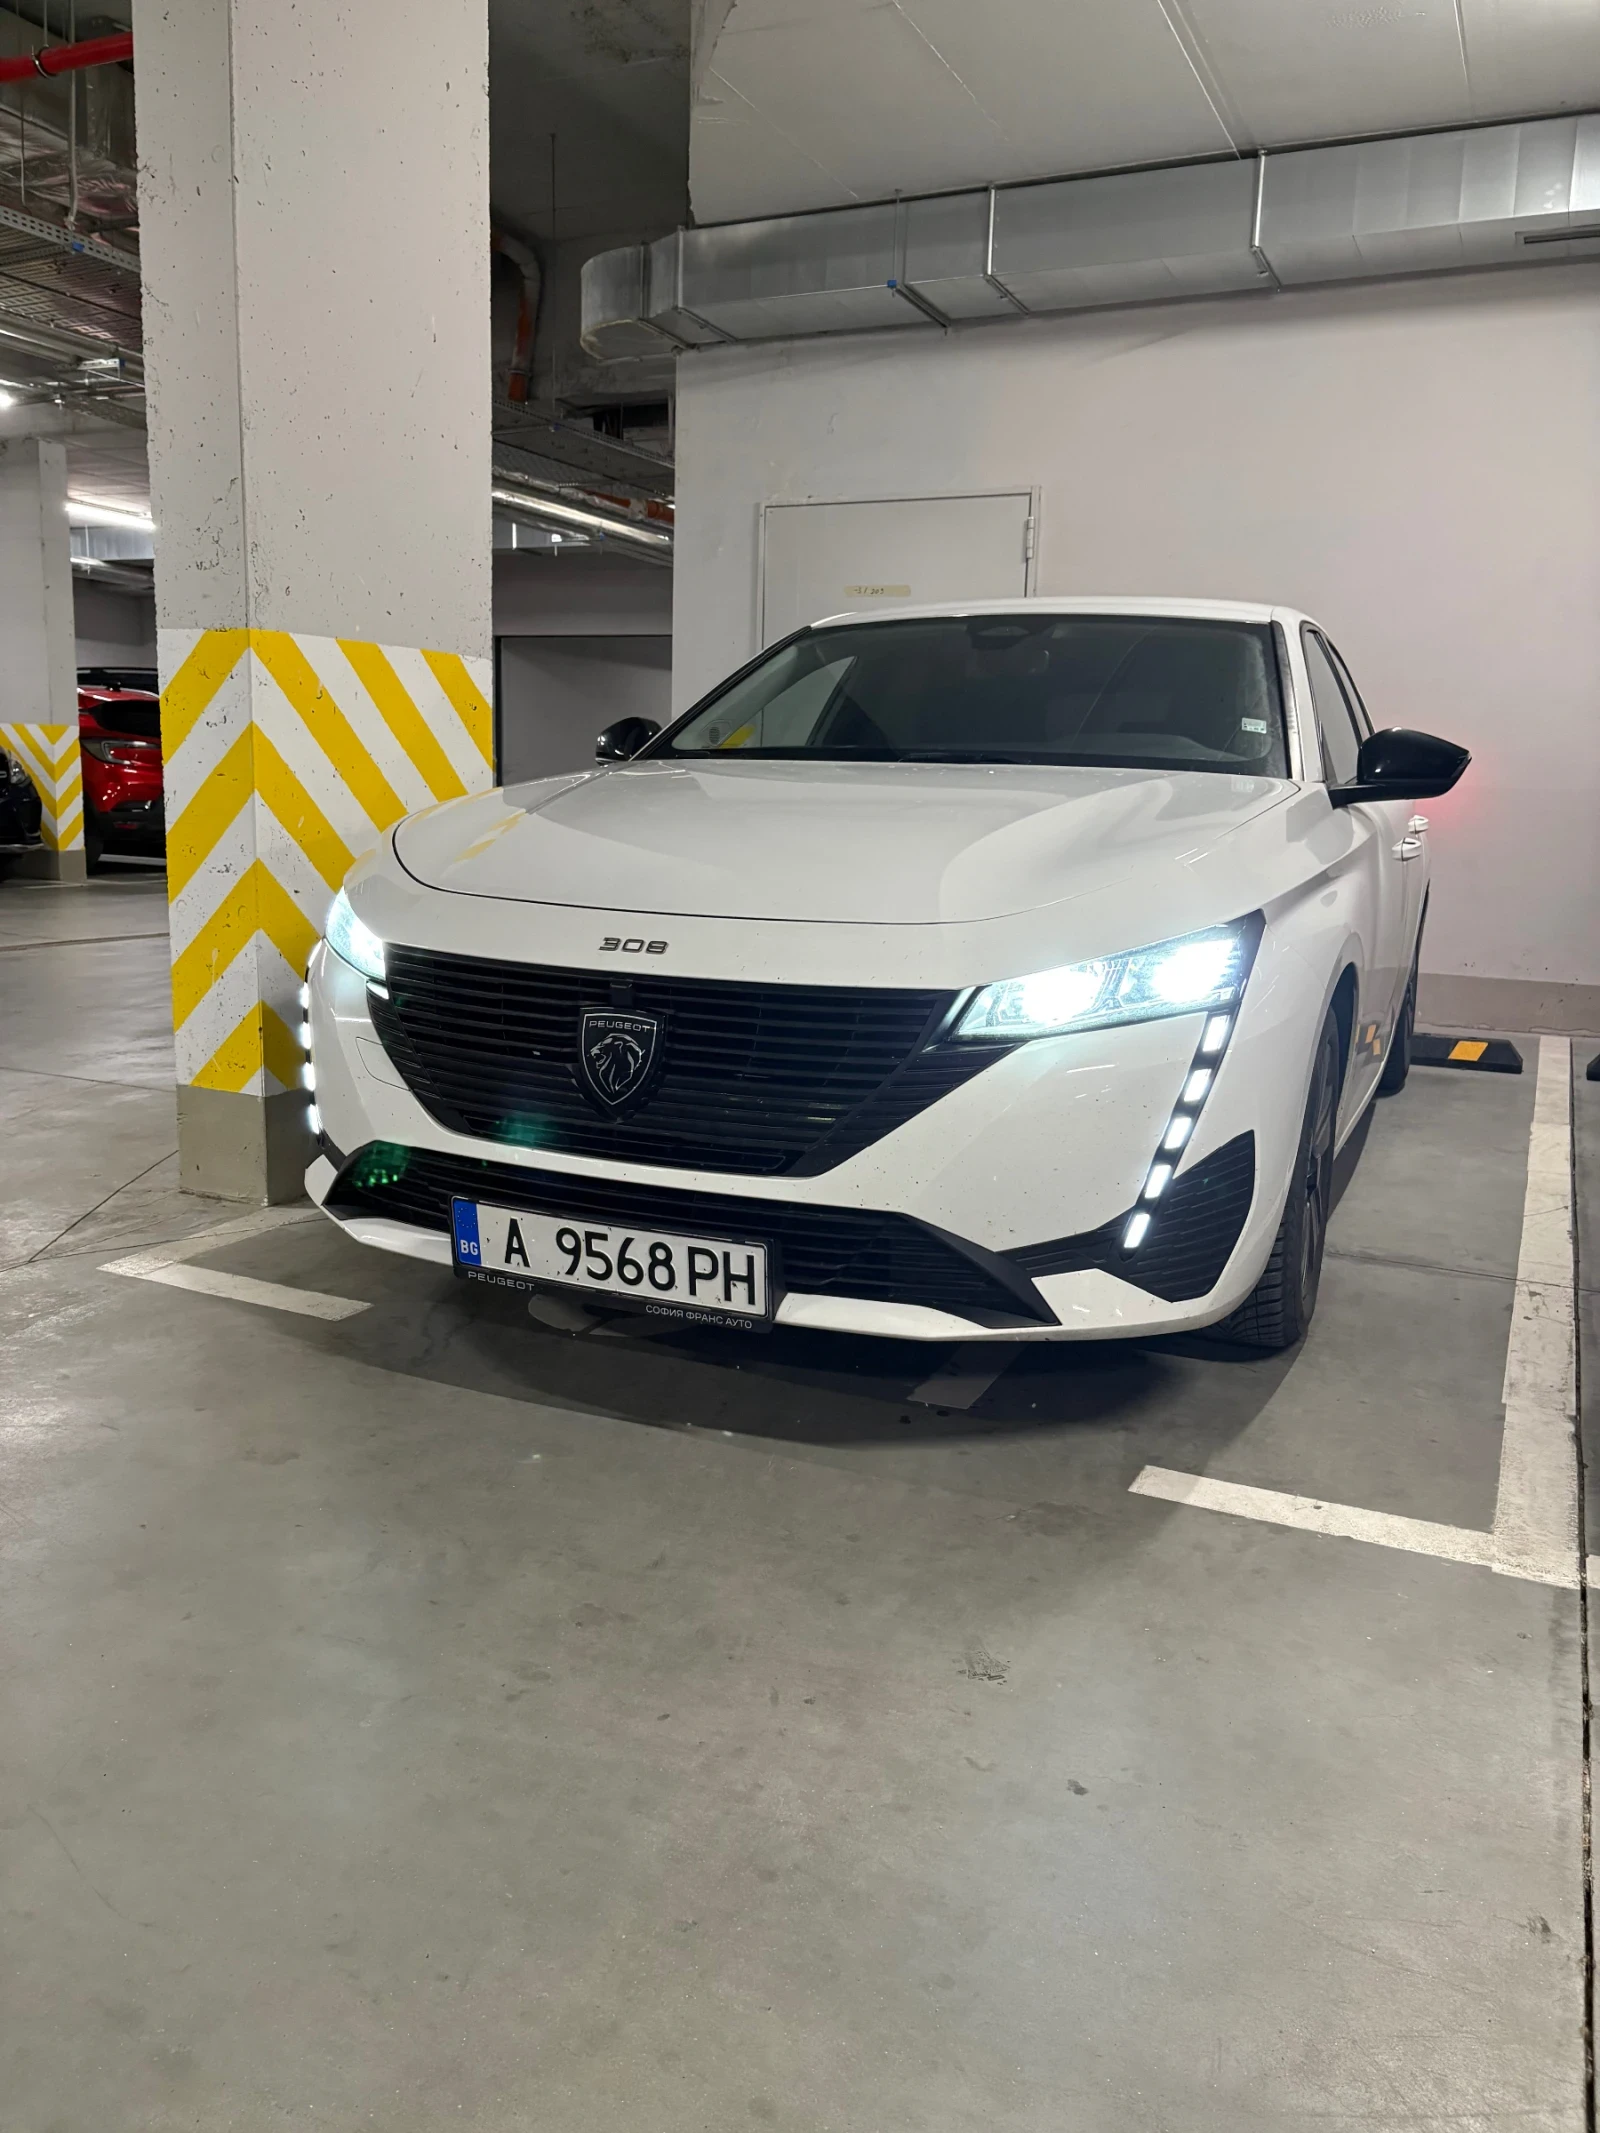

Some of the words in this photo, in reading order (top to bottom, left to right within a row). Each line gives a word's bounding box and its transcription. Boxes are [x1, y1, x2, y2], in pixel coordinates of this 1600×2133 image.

[599, 937, 668, 955] 308
[589, 1020, 651, 1033] PEUGEOT
[460, 1239, 479, 1256] BG
[556, 1227, 676, 1291] 9568
[467, 1270, 535, 1291] PEUGEOT
[645, 1304, 684, 1318] СОФИЯ
[685, 1311, 724, 1325] ФРАНС
[725, 1317, 753, 1330] АУТО
